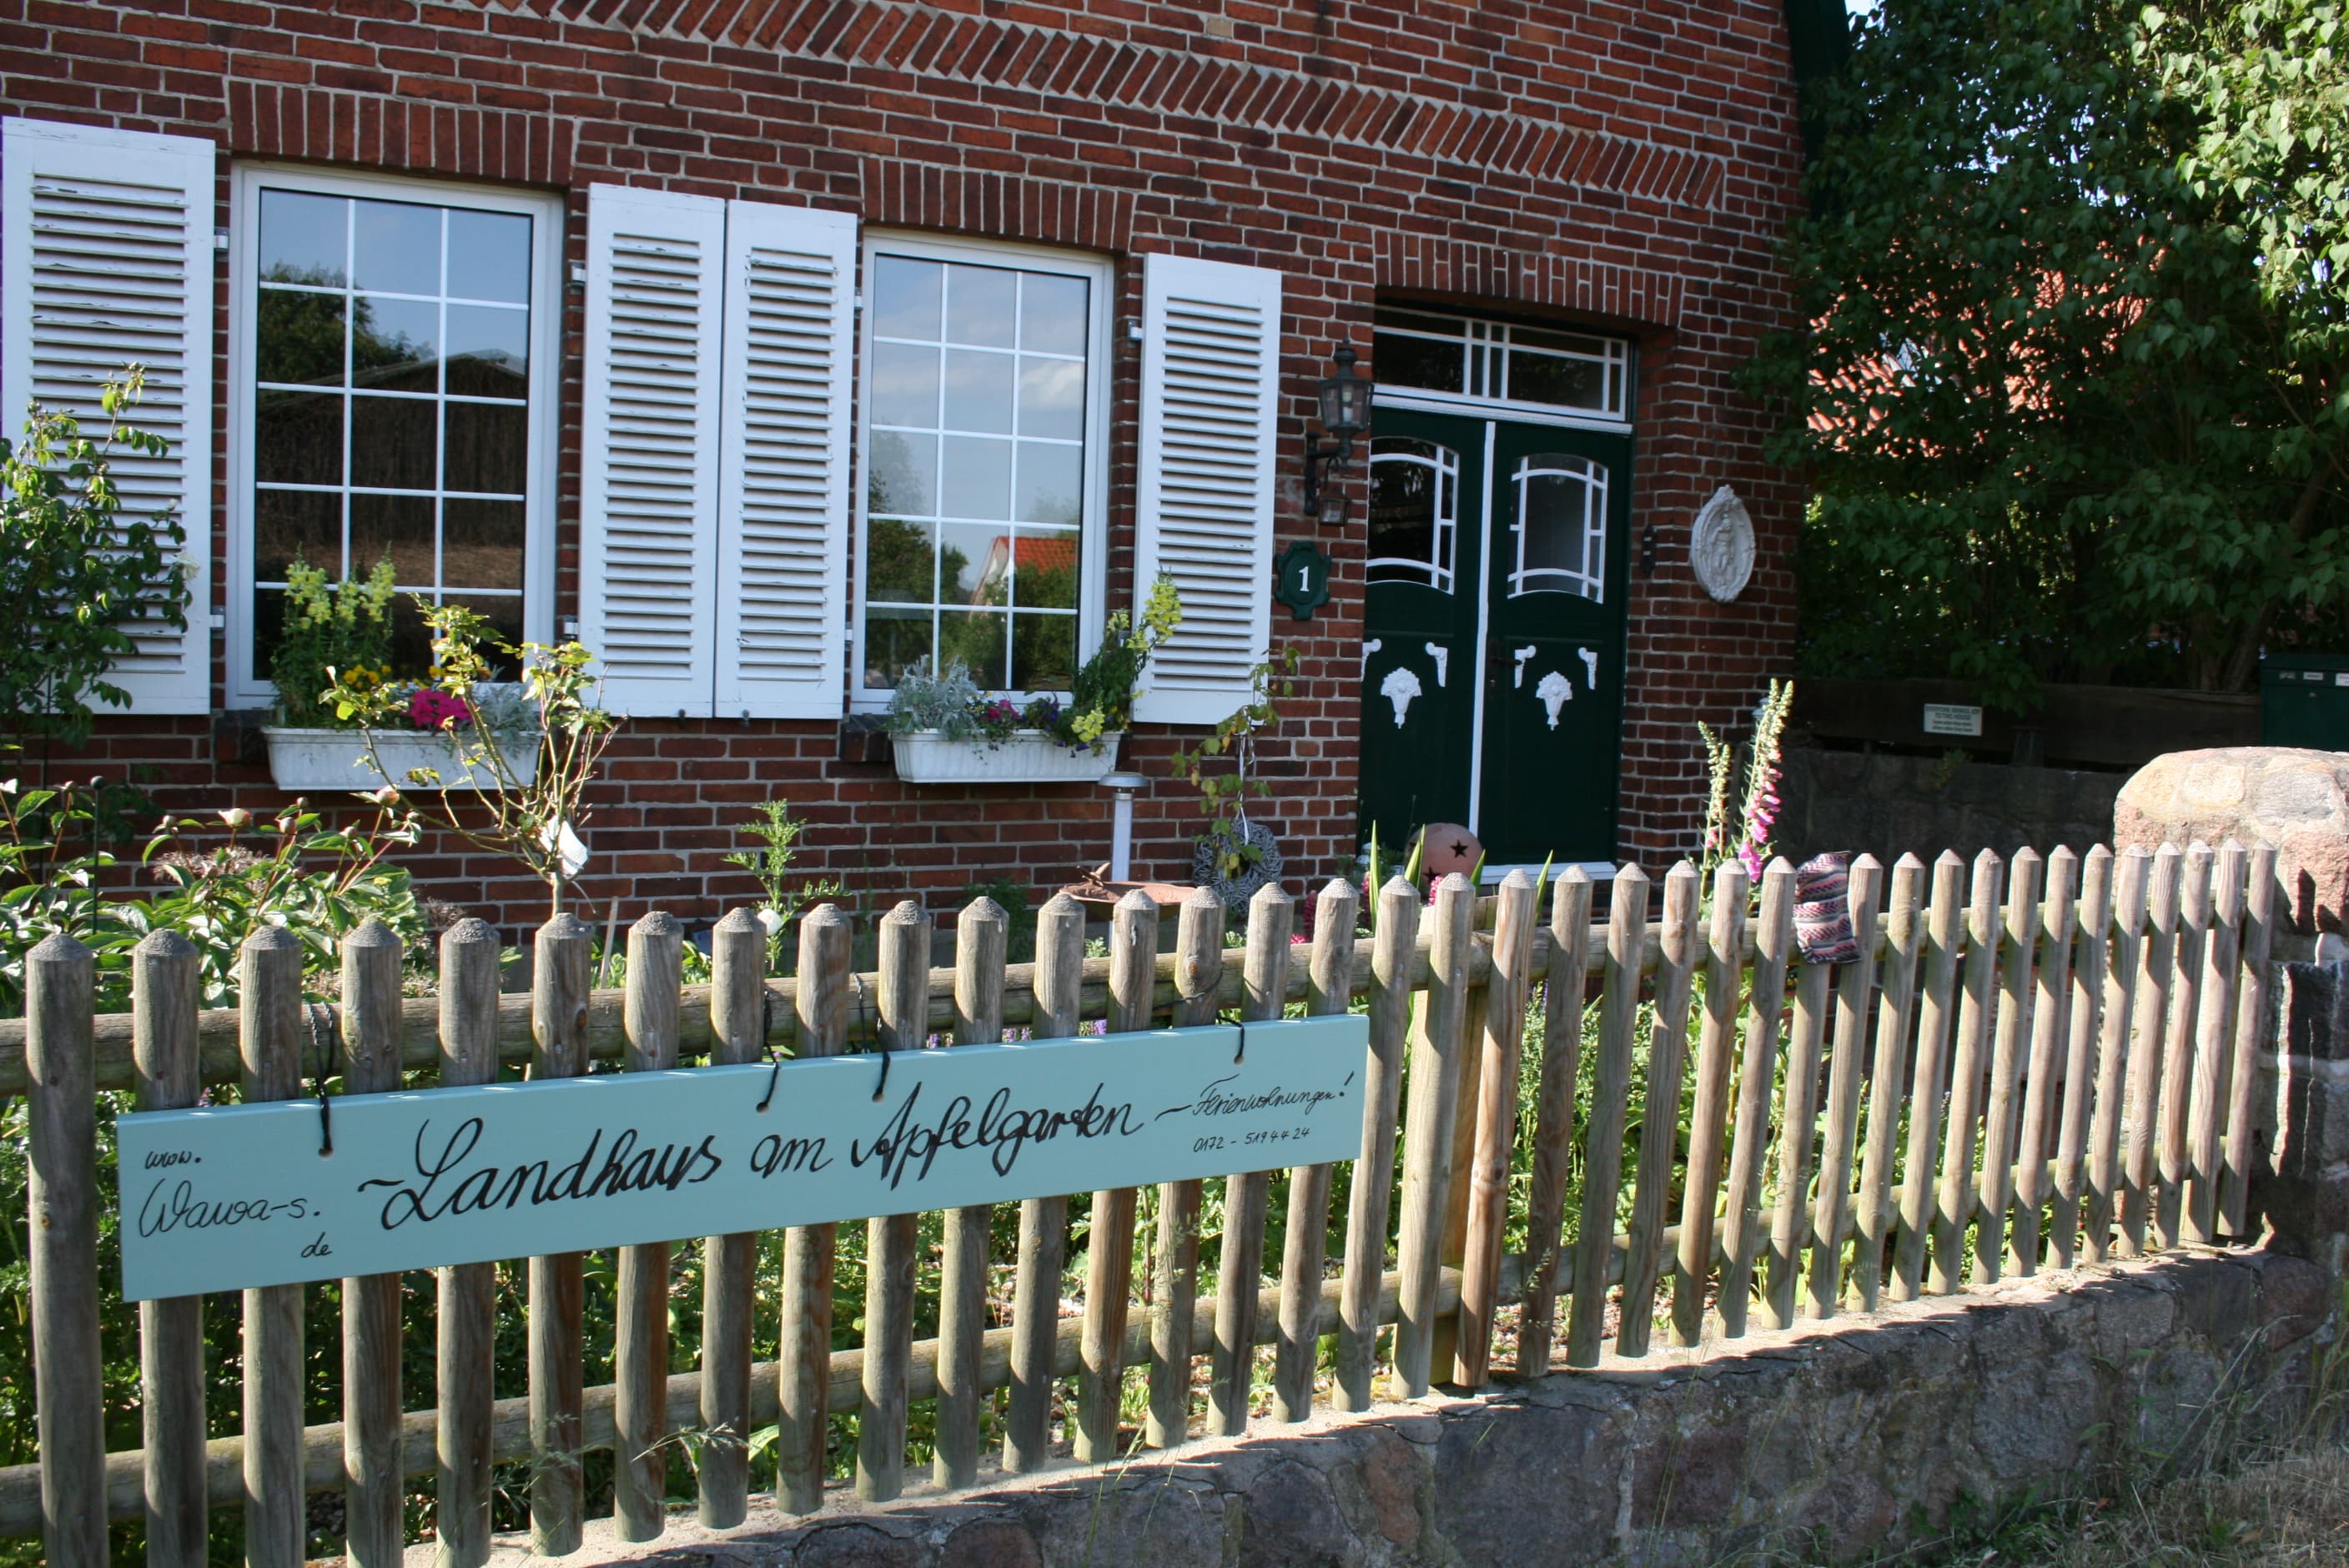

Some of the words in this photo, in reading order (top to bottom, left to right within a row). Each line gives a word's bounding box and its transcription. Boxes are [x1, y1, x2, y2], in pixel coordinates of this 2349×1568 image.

[1298, 565, 1310, 592] 1
[751, 1133, 833, 1179] am
[850, 1082, 1146, 1191] Apfelgarten
[1193, 1137, 1225, 1153] 0172
[145, 1150, 202, 1169] www.
[301, 1231, 333, 1258] de
